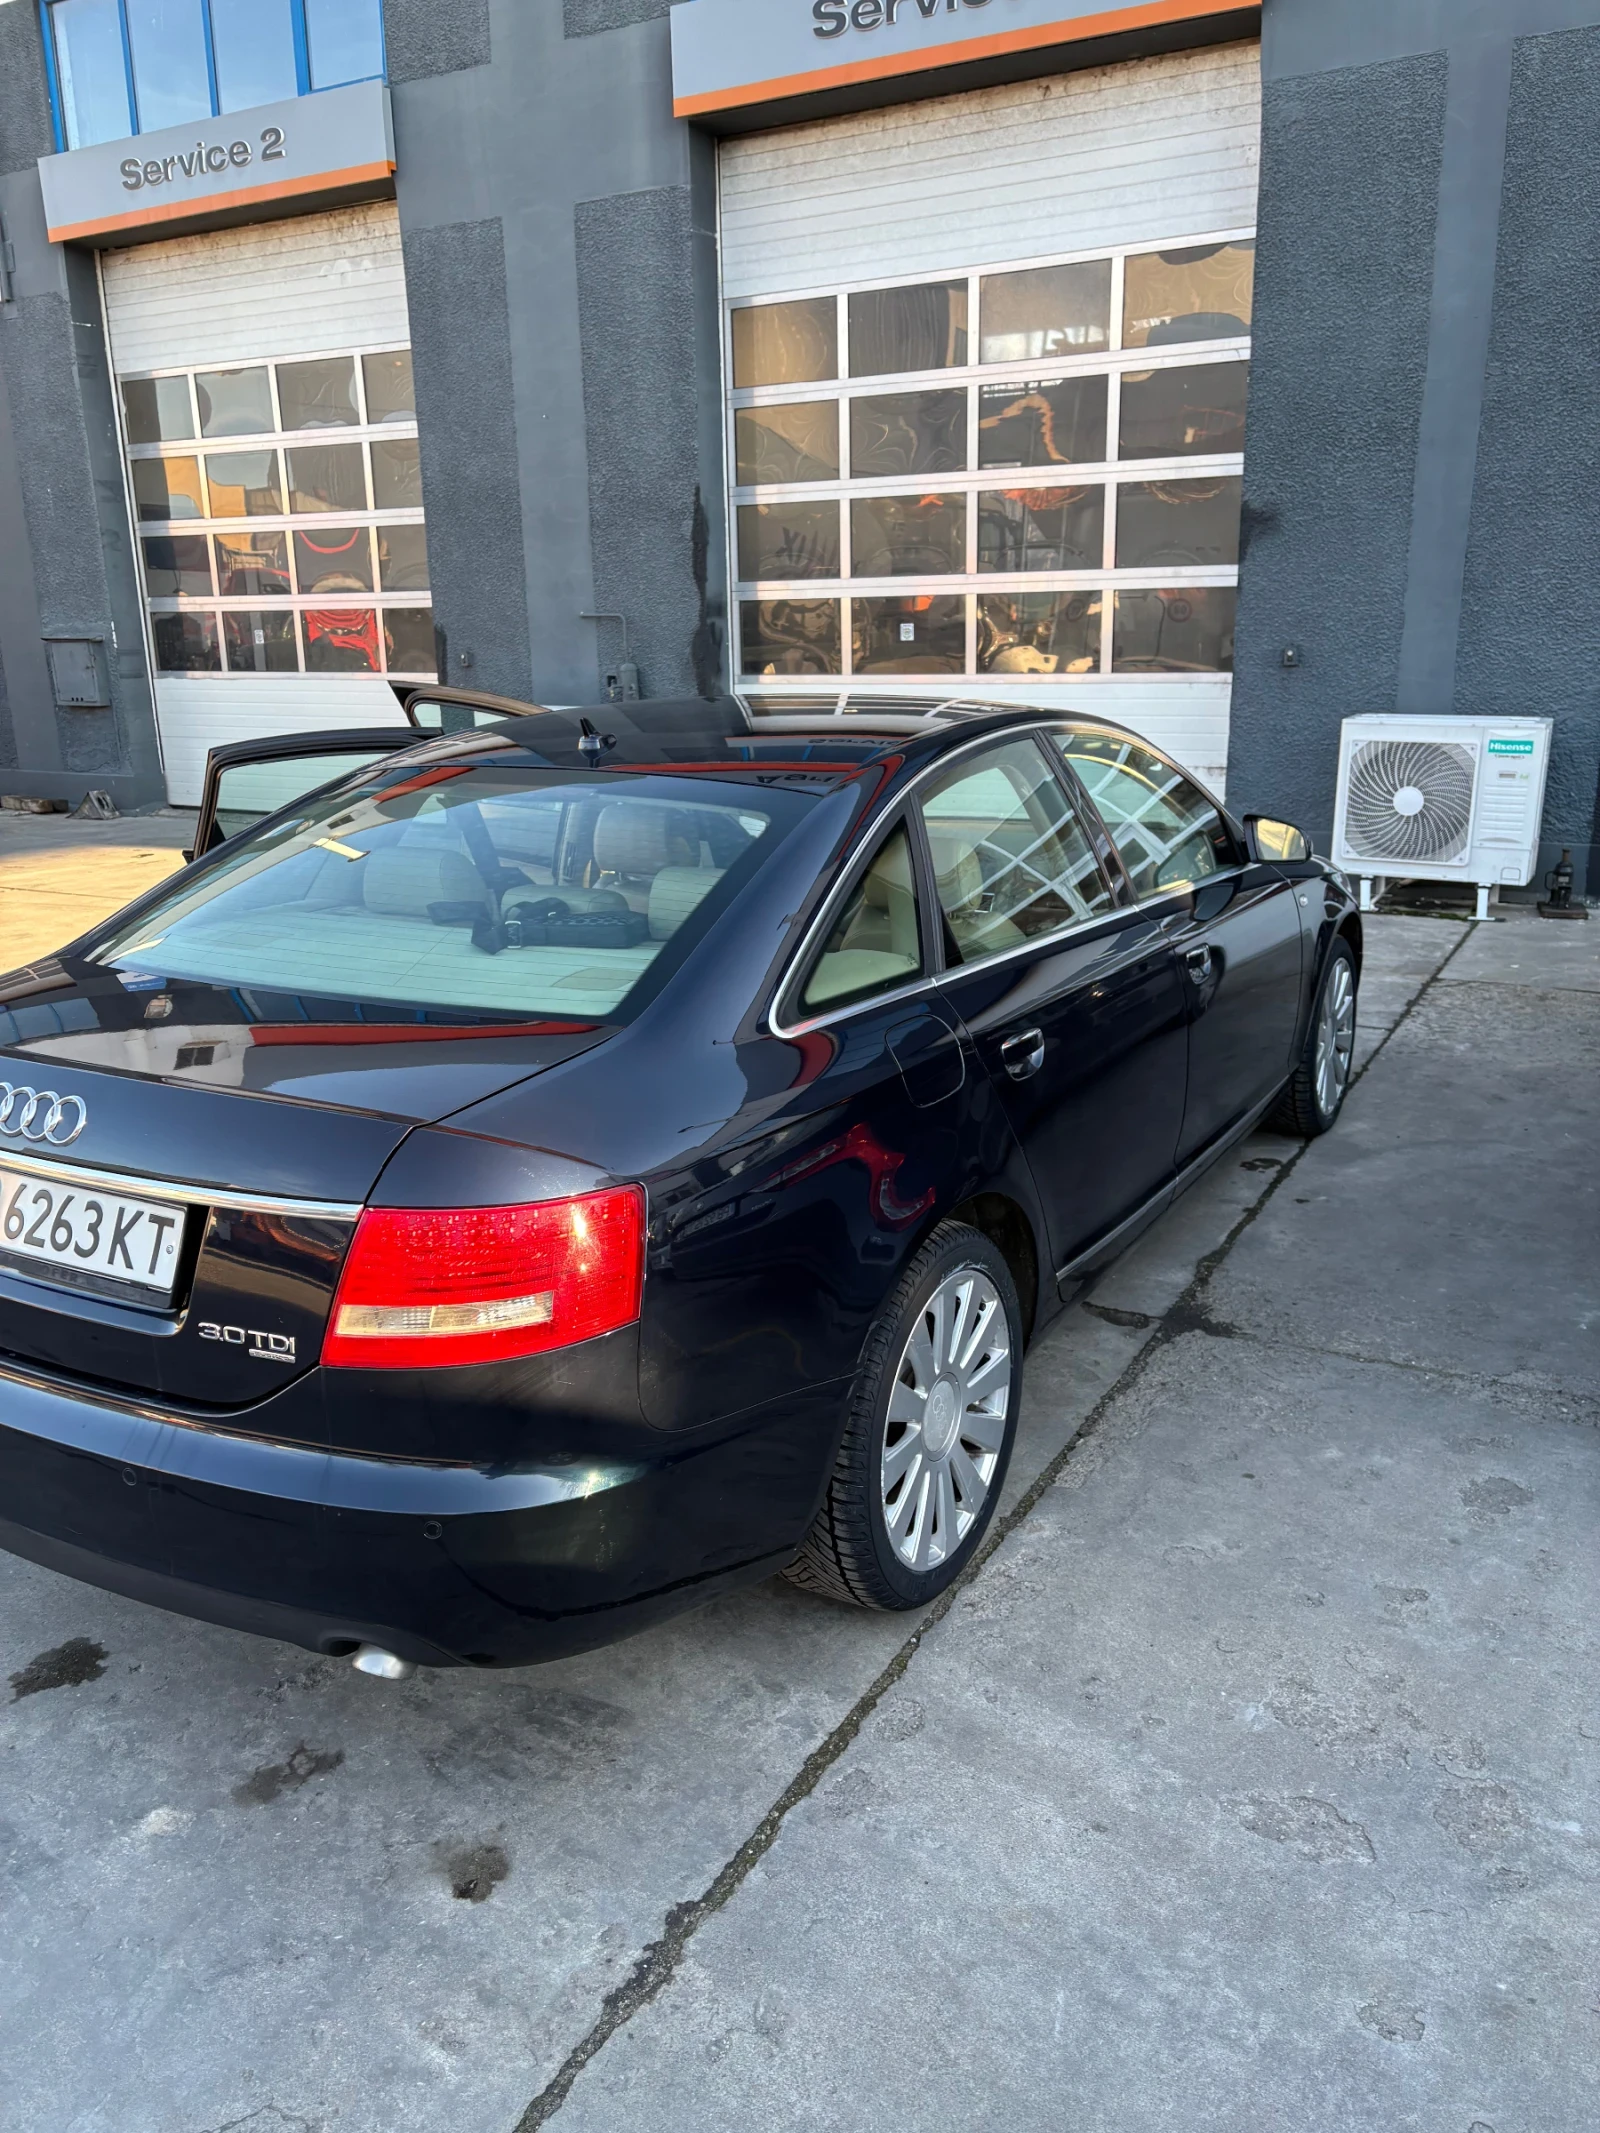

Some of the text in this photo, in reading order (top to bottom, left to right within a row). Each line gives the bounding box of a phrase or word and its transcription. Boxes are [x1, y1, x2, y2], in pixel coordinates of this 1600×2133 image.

[120, 126, 287, 190] Service 2
[1490, 742, 1532, 751] Hisense
